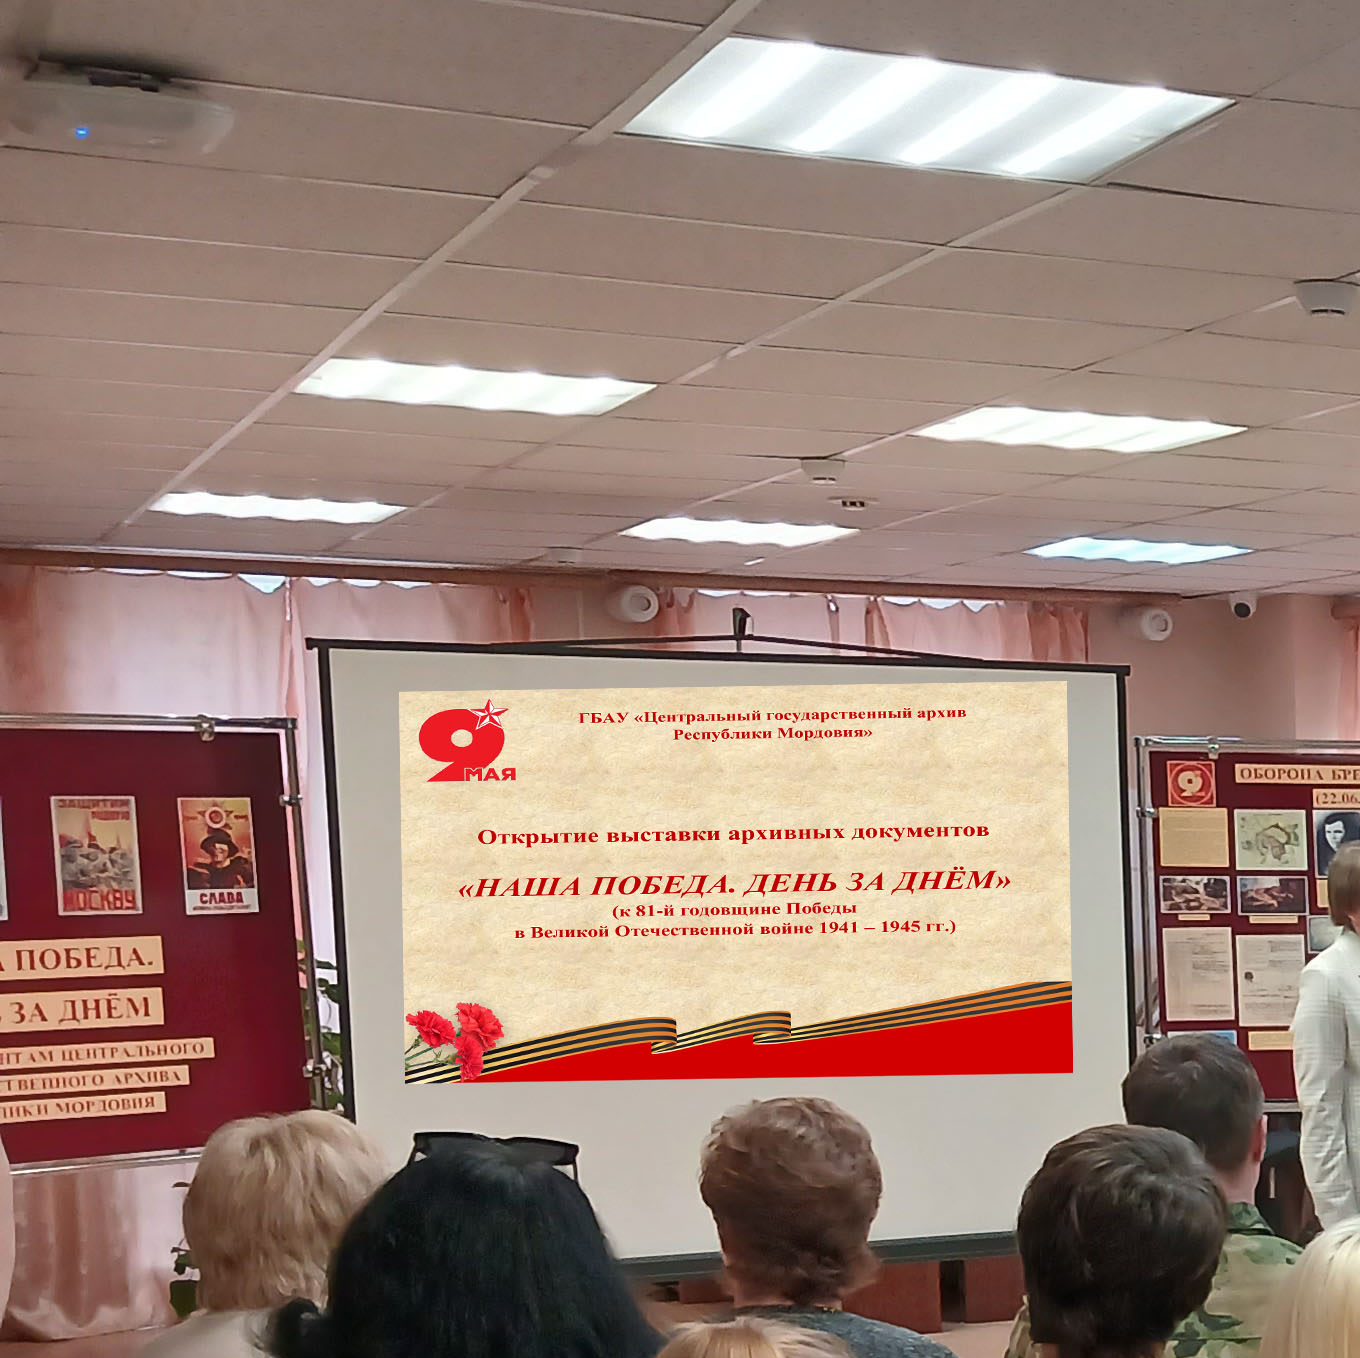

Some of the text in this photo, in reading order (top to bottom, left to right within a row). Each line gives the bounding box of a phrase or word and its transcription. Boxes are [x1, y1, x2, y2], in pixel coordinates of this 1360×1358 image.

[579, 707, 967, 726] ГБАУ «Центральный государственный архив
[673, 727, 873, 743] Республики Мордовия»
[418, 708, 505, 782] 9
[464, 767, 517, 782] МАЯ
[1240, 767, 1324, 781] ОБОРОНА
[477, 825, 990, 848] Открытие выставки архивных документов
[458, 866, 1012, 899] «НАША ПОБЕДА. ДЕНЬ ЗА ДНЁМ»
[612, 902, 857, 920] (к 81-й годовщине Победы
[514, 929, 525, 939] в
[531, 925, 609, 939] Великой
[614, 923, 754, 938] Отечественной
[760, 921, 814, 935] войне
[820, 920, 857, 934] 1941
[881, 919, 921, 933] 1945
[926, 919, 956, 935] гг.)
[16, 946, 153, 971] ПОБЕДА.
[10, 993, 151, 1026] ЗА ДНЁМ
[62, 1042, 205, 1062] ЦЕНТРАЛЬНОГО
[113, 1070, 181, 1085] АРХИВА
[56, 1096, 155, 1114] МОРДОВИЯ
